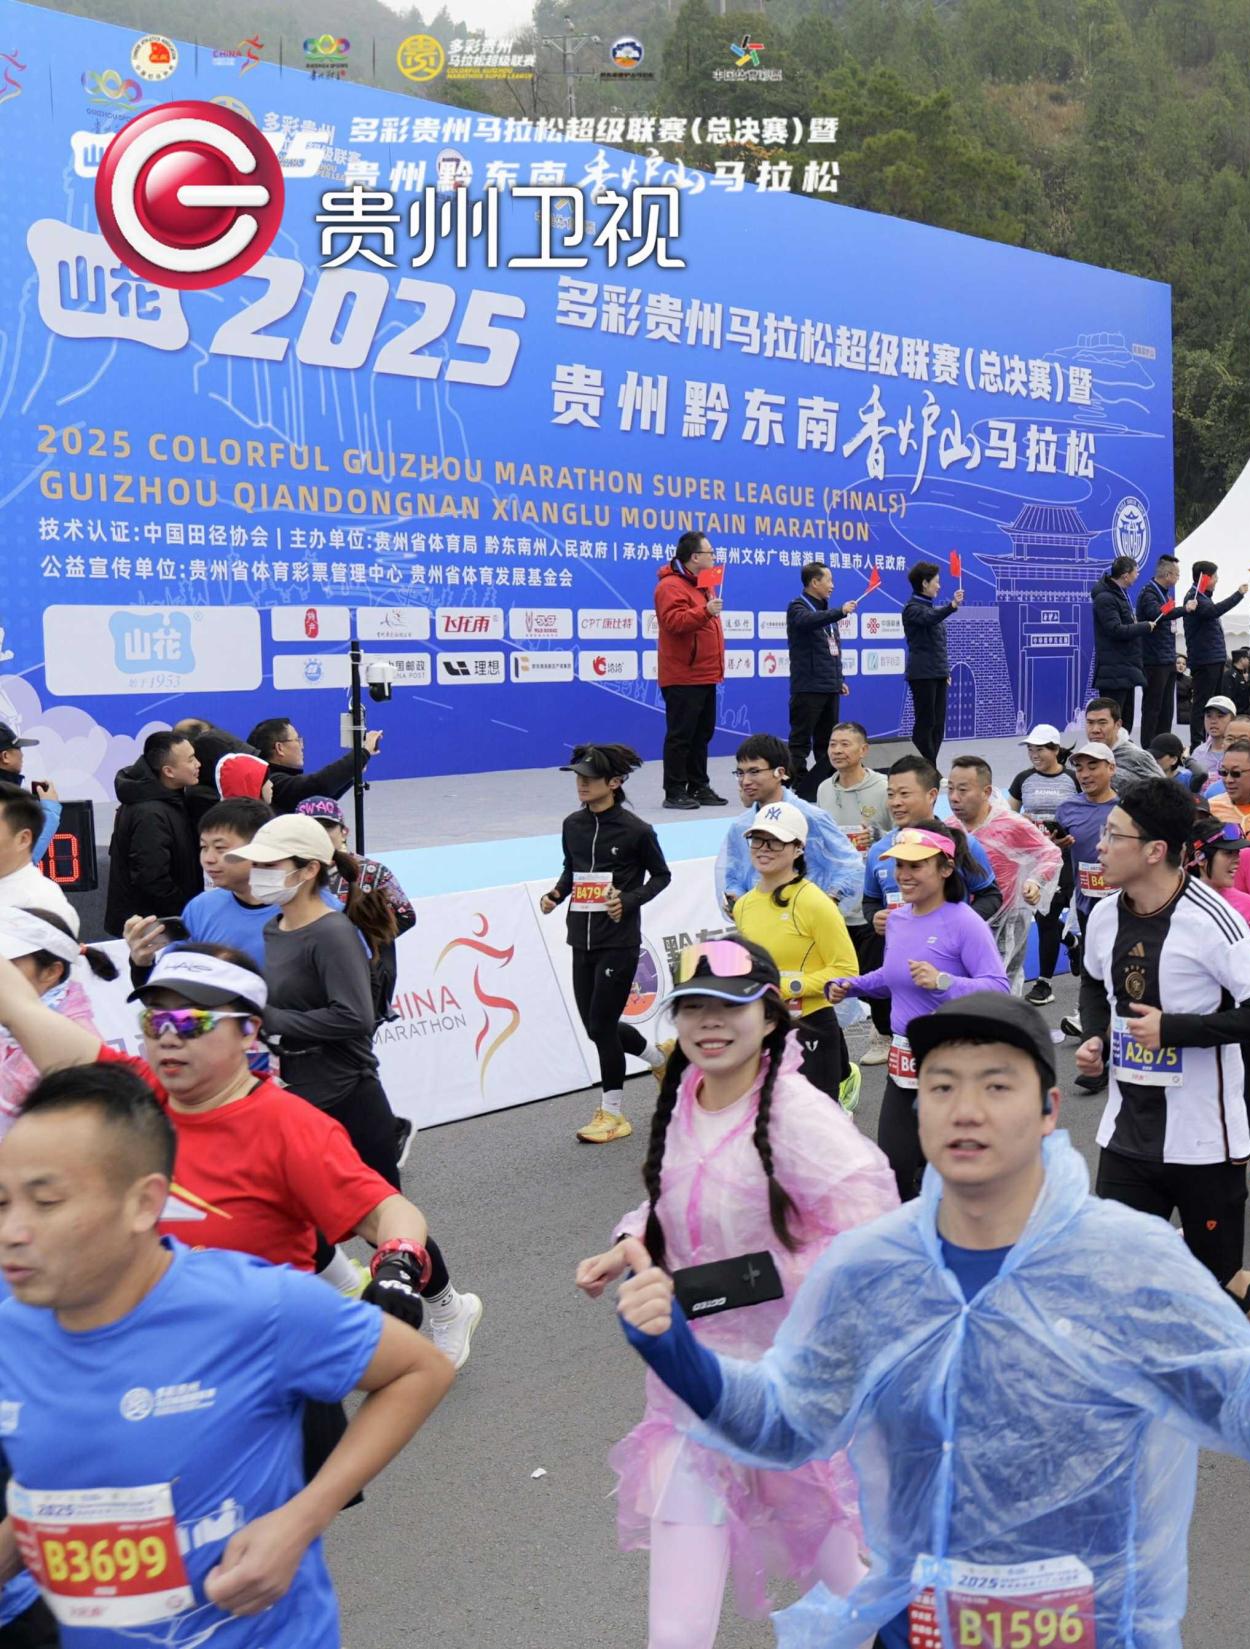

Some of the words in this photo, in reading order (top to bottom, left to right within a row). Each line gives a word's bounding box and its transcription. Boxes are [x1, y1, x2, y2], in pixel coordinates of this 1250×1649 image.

[209, 256, 526, 388] 2025
[556, 276, 1093, 407] 多彩贵州马拉松超级联赛(总决赛)暨
[550, 362, 1096, 495] 贵州黔东南香炉山马拉松
[37, 423, 132, 459] 2025
[148, 432, 329, 472] COLORFUL
[342, 447, 483, 484] GUIZHOU
[494, 459, 644, 496] MARATHON
[652, 473, 727, 502] SUPER
[734, 480, 817, 509] LEAGUE
[822, 487, 907, 519] (FINALS)
[39, 470, 219, 508] GUIZHOU
[233, 480, 482, 521] QIANDONGNAN
[491, 497, 611, 529] XIANGLU
[621, 506, 747, 535] MOUNTAIN
[754, 515, 870, 544] MARATHON
[38, 516, 270, 549] 技术认证:中国田径协会
[289, 526, 478, 555] 主办单位:贵州省体育局
[484, 534, 608, 560] 黔东南州人民政府
[829, 551, 907, 572] 凯里市人民政府
[40, 553, 403, 586] 公益宣传单位:贵州省体育彩票管理中心
[410, 564, 574, 588] 贵州省体育发展基金会
[124, 627, 182, 660] 山花
[441, 615, 491, 633] 飞龙雨
[474, 659, 501, 677] 理想
[391, 985, 462, 1022] HINA
[371, 1012, 467, 1046] MARATHON
[43, 1535, 168, 1583] B3699
[957, 1573, 999, 1591] 2025
[958, 1604, 1085, 1649] B1596
